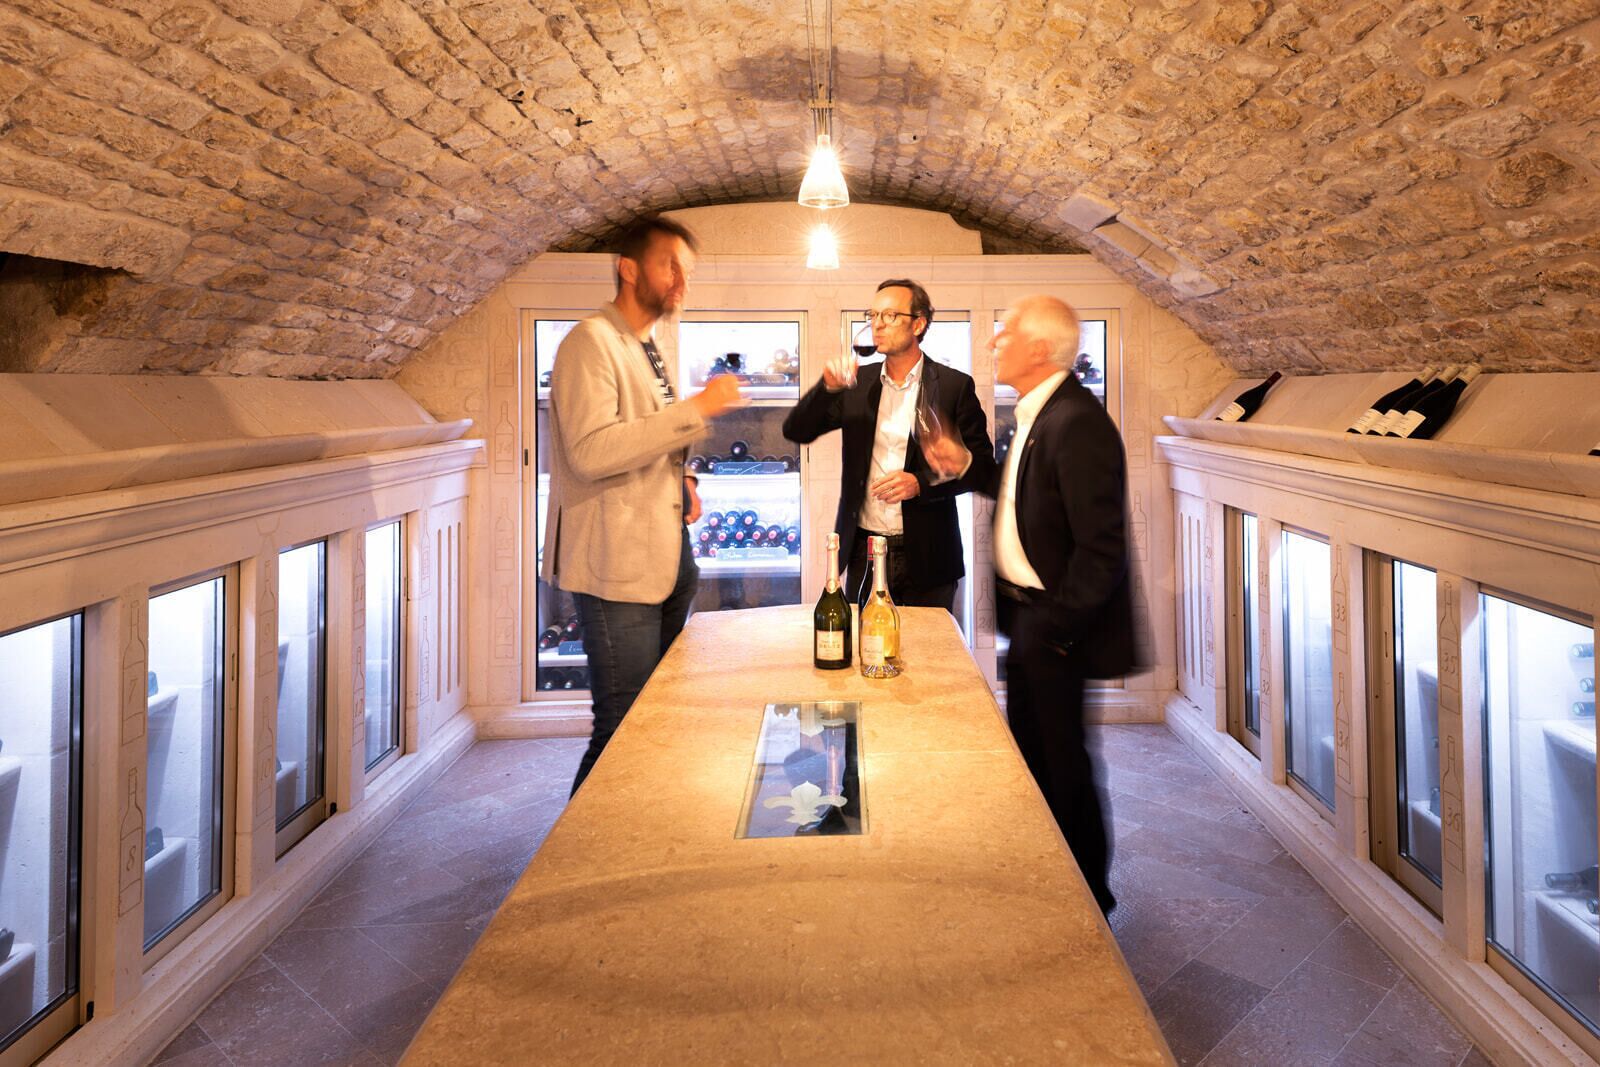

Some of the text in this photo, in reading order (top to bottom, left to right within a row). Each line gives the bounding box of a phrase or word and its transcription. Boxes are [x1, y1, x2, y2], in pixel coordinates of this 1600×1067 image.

[1335, 603, 1346, 622] 33
[1442, 651, 1458, 674] 35
[128, 677, 139, 704] 7
[1338, 730, 1350, 752] 34
[260, 757, 272, 781] 10
[1445, 806, 1460, 833] 36
[126, 844, 137, 872] 8
